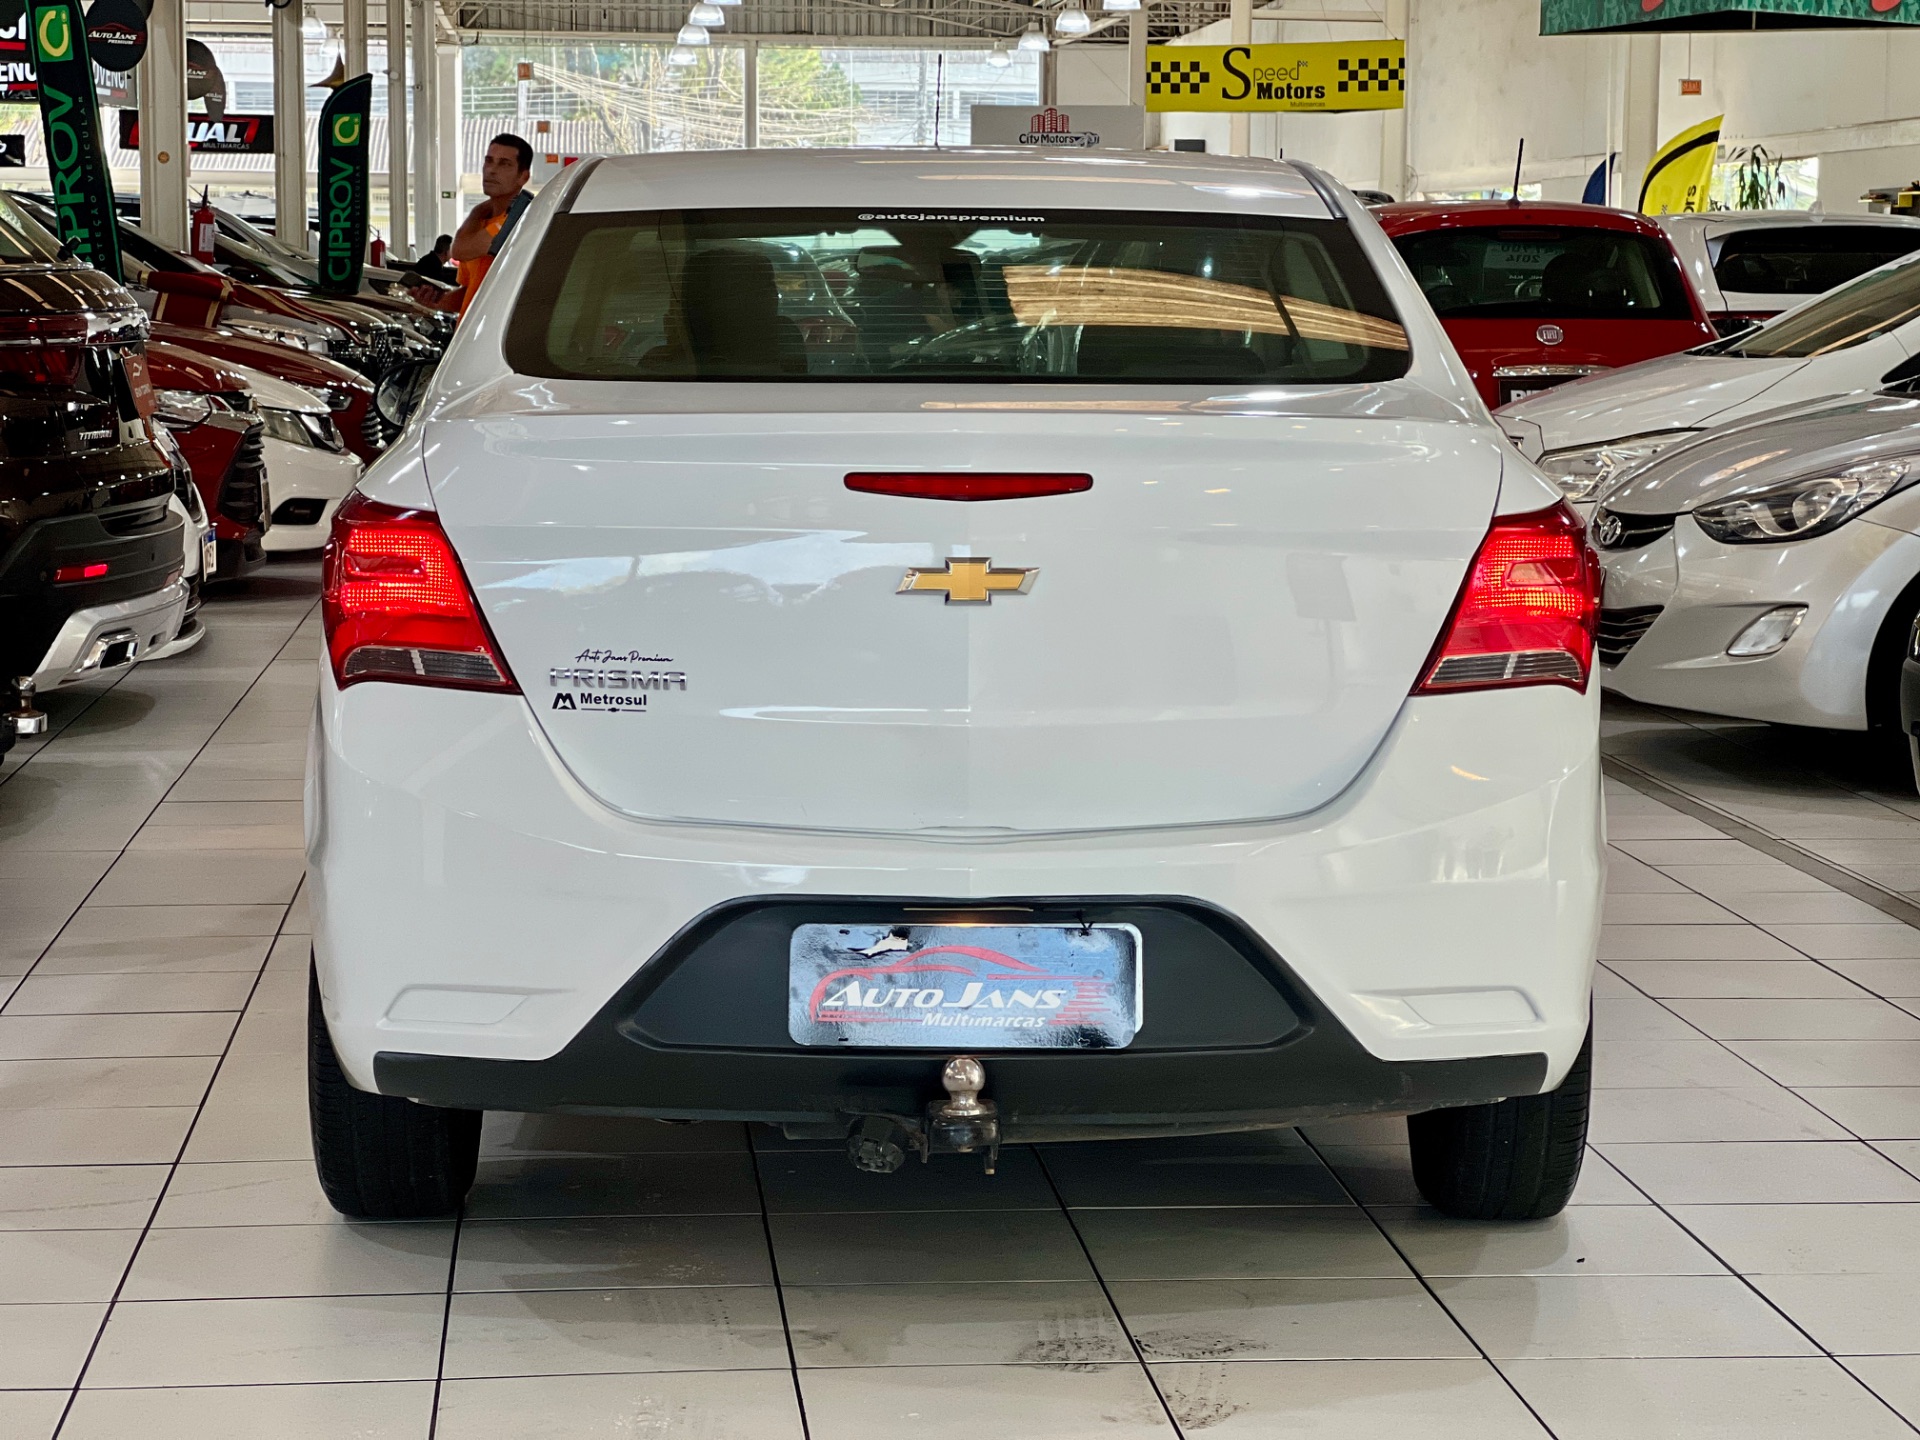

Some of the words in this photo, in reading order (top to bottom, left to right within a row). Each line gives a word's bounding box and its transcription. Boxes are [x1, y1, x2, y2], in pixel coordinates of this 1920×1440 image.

[1222, 47, 1299, 100] Speed
[1257, 82, 1326, 99] Motors
[1019, 133, 1040, 145] City
[1041, 134, 1075, 144] Motors
[43, 84, 93, 262] IPROV
[328, 157, 354, 281] CIPROV
[858, 213, 1045, 222] @autojanspremium
[575, 648, 602, 663] Auto
[628, 650, 674, 663] Premium
[550, 667, 688, 691] PRISMA
[580, 693, 647, 706] Metrosul
[921, 1011, 1046, 1028] Multimarcas
